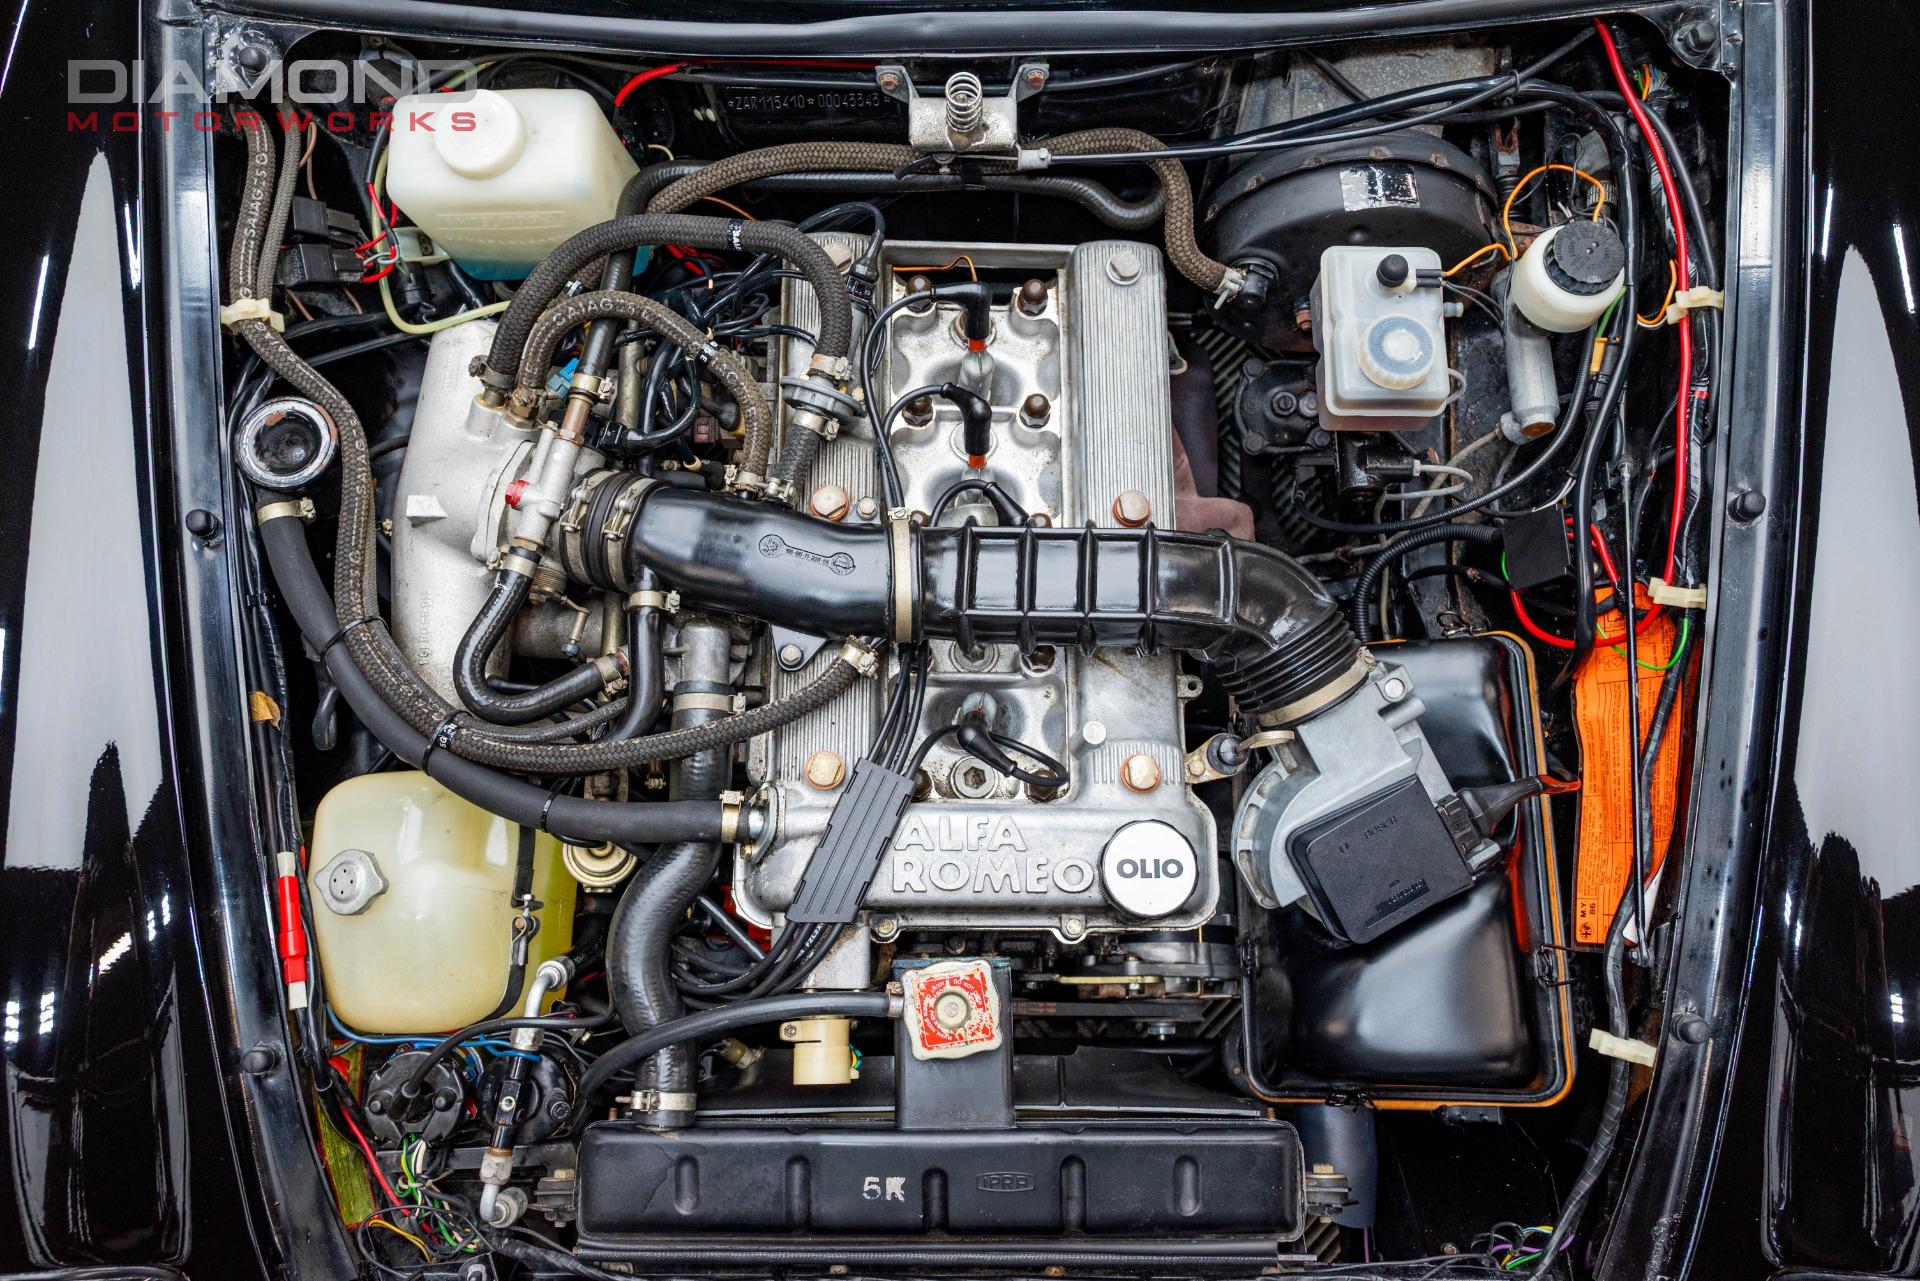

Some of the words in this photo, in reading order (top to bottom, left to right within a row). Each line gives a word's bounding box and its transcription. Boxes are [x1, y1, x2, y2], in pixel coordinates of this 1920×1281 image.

[894, 814, 1028, 851] ALFA
[892, 856, 1095, 893] ROMEO
[1116, 858, 1184, 879] OLIO
[1589, 903, 1596, 915] 86
